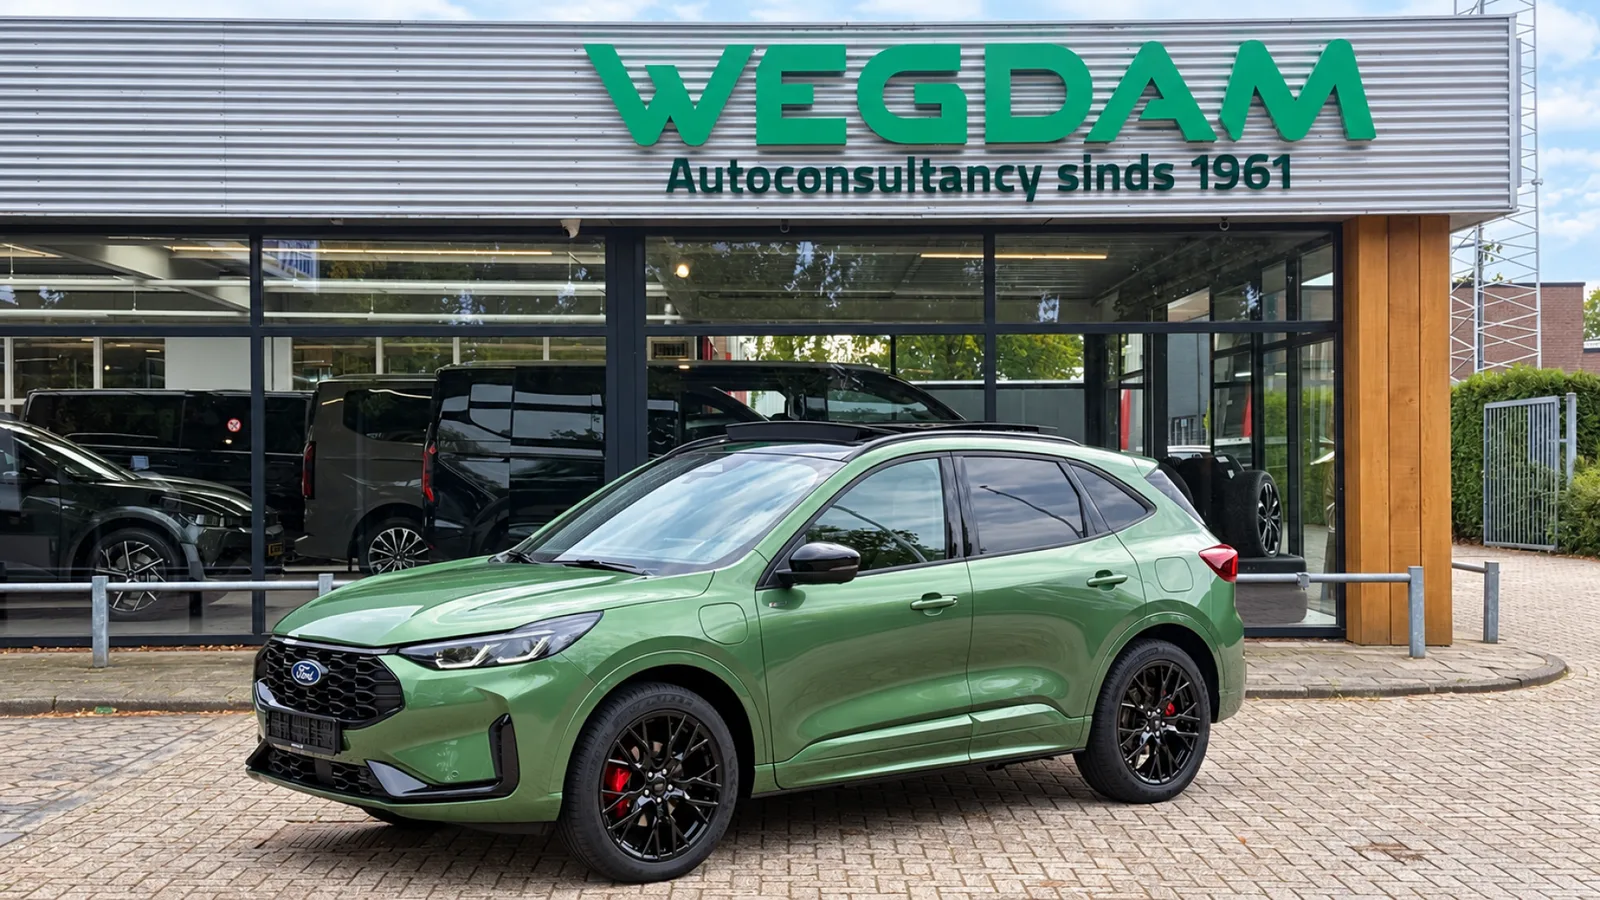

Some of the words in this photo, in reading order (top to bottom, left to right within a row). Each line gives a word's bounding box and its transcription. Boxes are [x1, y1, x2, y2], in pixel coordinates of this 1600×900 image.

[583, 38, 1376, 146] WEGDAM
[666, 156, 1043, 202] Autoconsultancy
[1057, 153, 1174, 192] sinds
[1191, 153, 1291, 190] 1961
[296, 664, 315, 681] Ford
